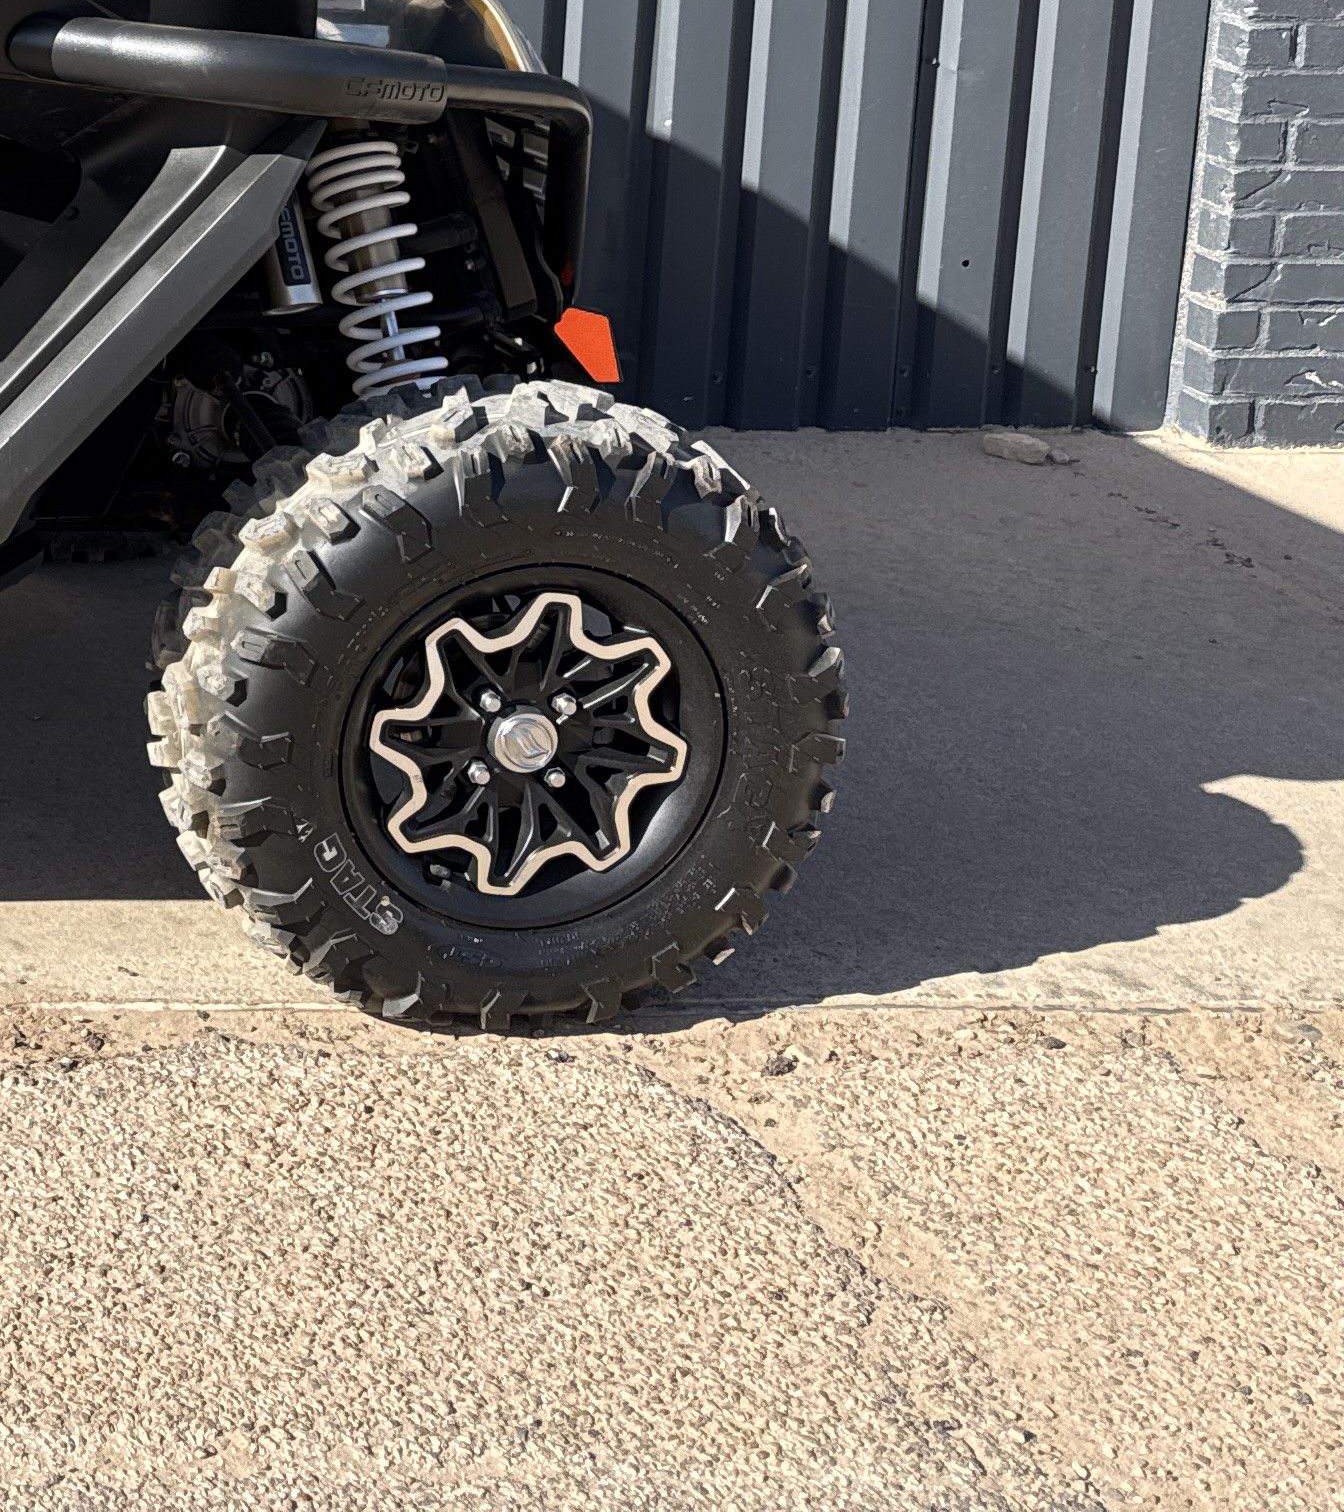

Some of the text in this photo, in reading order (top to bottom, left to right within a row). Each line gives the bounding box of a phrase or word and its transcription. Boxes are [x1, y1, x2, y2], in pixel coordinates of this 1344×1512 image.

[346, 76, 445, 102] CFMOTO
[279, 207, 305, 280] FMOTO
[314, 832, 404, 935] STAG
